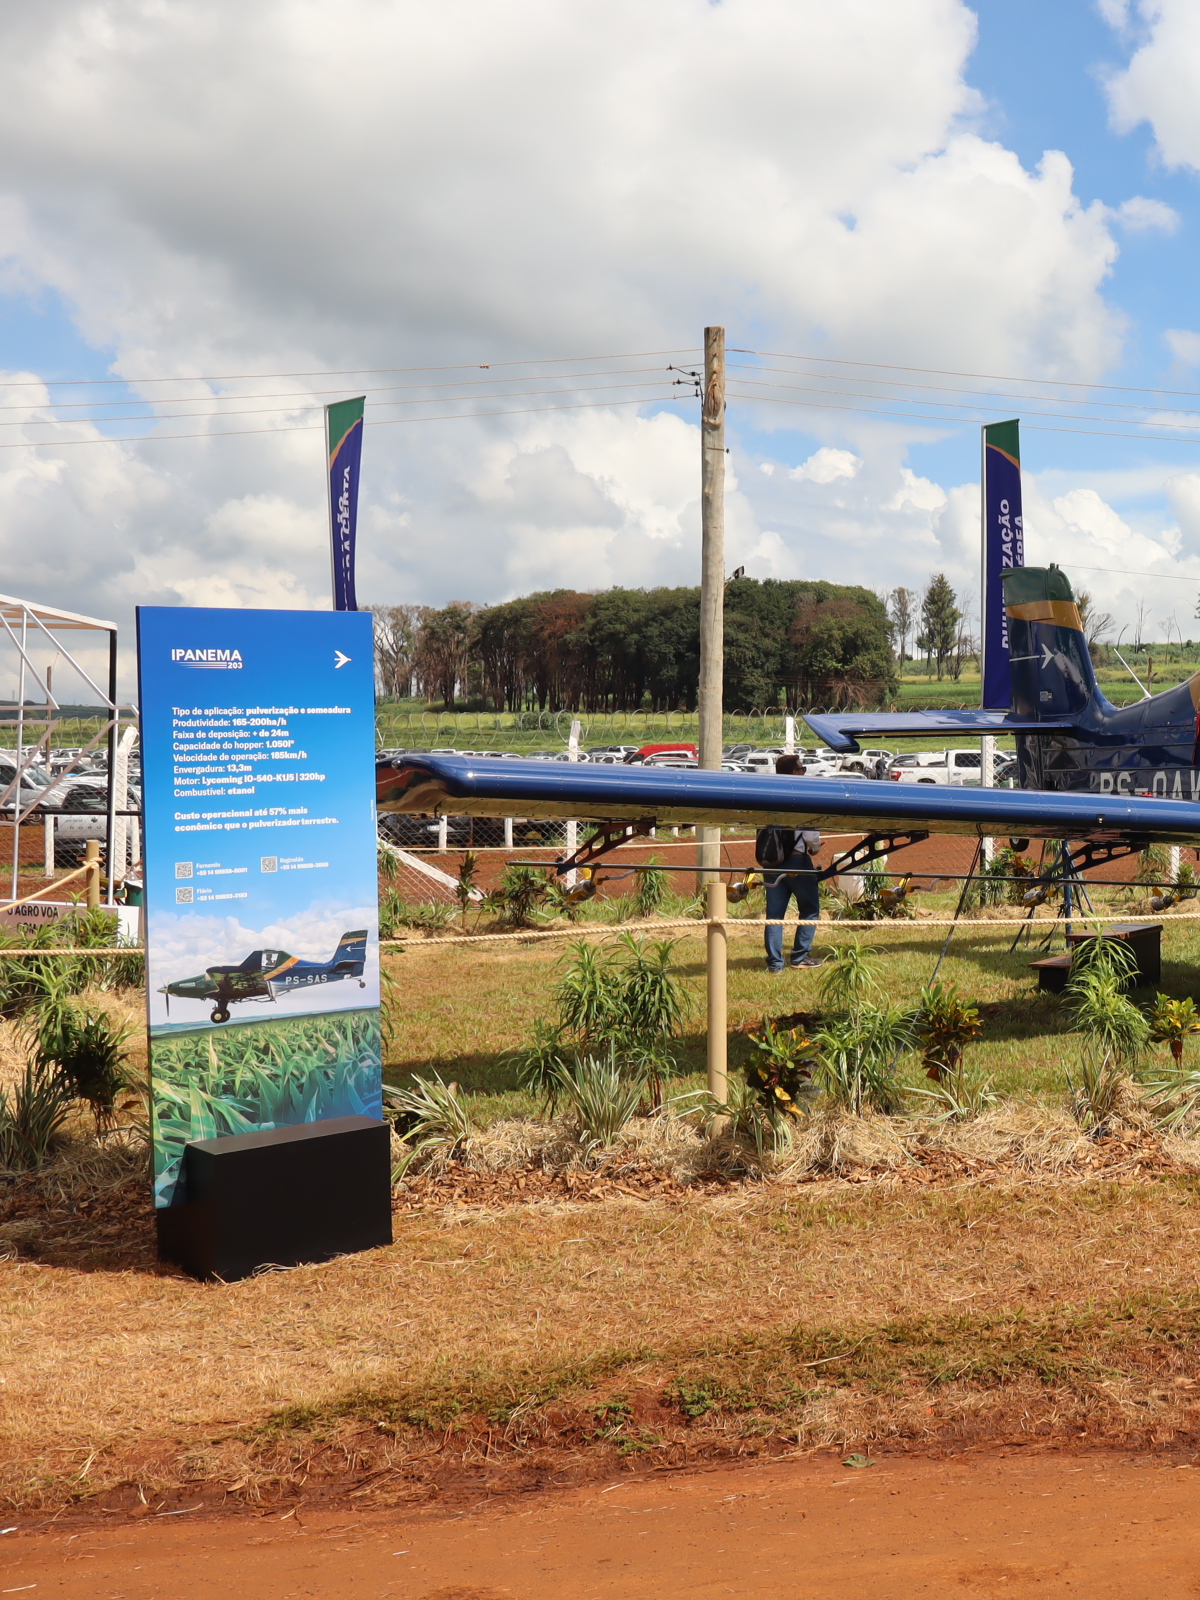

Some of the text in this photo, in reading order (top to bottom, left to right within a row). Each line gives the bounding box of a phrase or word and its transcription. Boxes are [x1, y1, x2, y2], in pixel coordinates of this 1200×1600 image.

[171, 649, 242, 661] IPANEMA
[172, 707, 190, 717] Tipo
[192, 707, 203, 715] de
[204, 707, 244, 717] aplicação:
[246, 706, 298, 716] pulverização
[307, 706, 351, 714] semeadura
[173, 718, 287, 727] Produtividade: 165-200ha/h
[196, 730, 206, 738] de
[208, 730, 250, 739] deposição:
[259, 729, 269, 737] de
[271, 729, 289, 737] 24m
[173, 742, 221, 751] Capacidade
[234, 742, 264, 750] hopper:
[173, 751, 307, 762] Velocidade de operação: 185km/h
[174, 764, 252, 774] Envergadura: 13,3m
[174, 777, 200, 785] Motor:
[202, 775, 243, 785] Lycoming
[300, 773, 325, 781] 320hp
[174, 786, 255, 797] Combustível: etanol
[174, 812, 200, 820] Custo
[202, 809, 252, 820] operacional
[254, 808, 268, 817] até
[269, 808, 287, 816] 57%
[175, 821, 222, 832] econômico
[224, 822, 240, 830] que
[249, 818, 300, 829] pulverizador
[302, 817, 339, 825] terrestre.
[15, 906, 39, 917] AGRO
[285, 974, 327, 984] PS-SAS
